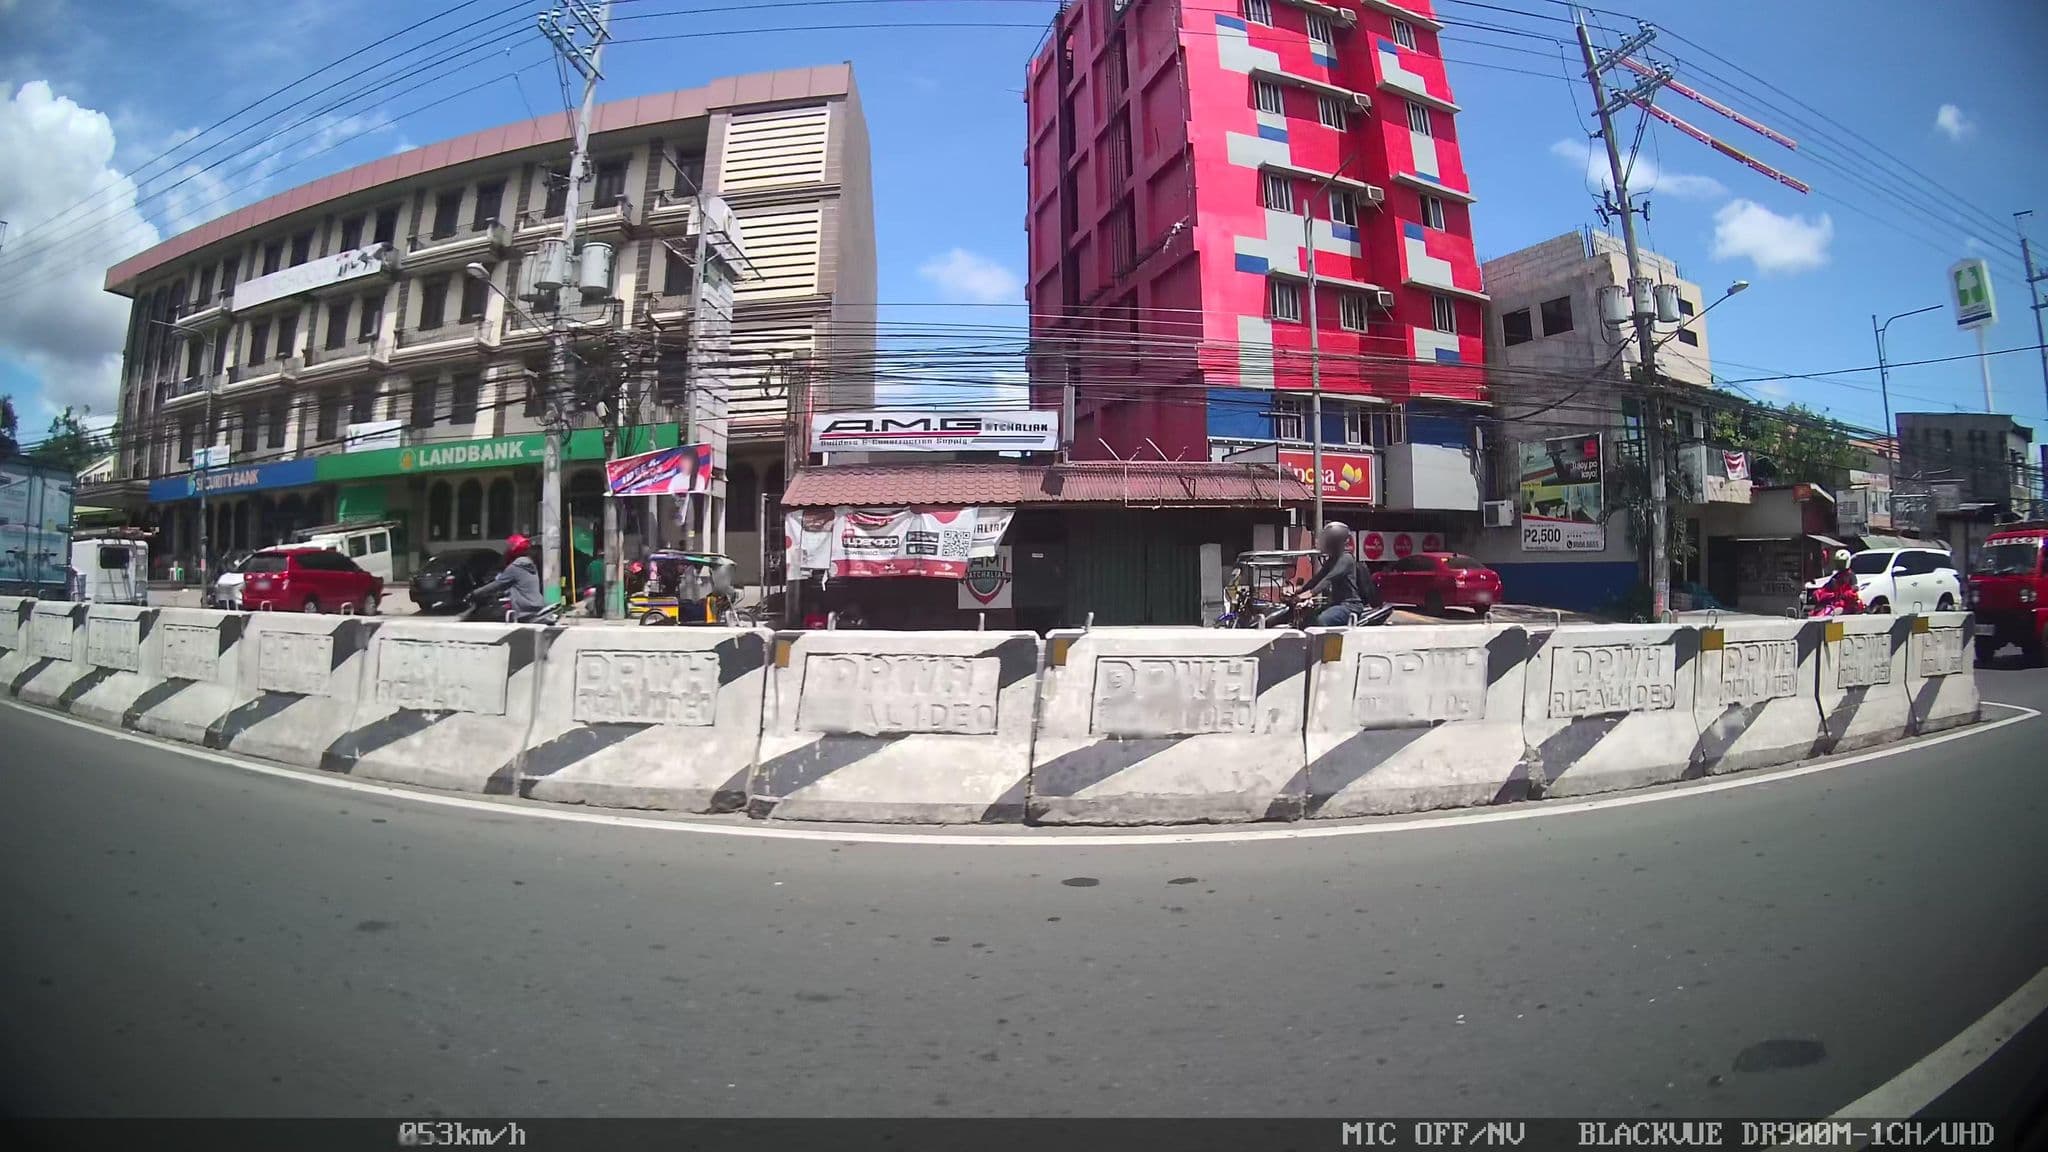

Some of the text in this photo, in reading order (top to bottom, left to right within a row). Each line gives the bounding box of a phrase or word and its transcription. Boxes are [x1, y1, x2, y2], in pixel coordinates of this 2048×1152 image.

[419, 441, 524, 467] LANDBANK
[233, 469, 259, 486] BANK
[1523, 529, 1561, 544] P2,500
[1571, 647, 1661, 680] DPWH
[1725, 642, 1796, 673] DPWH
[1636, 684, 1673, 705] DEO
